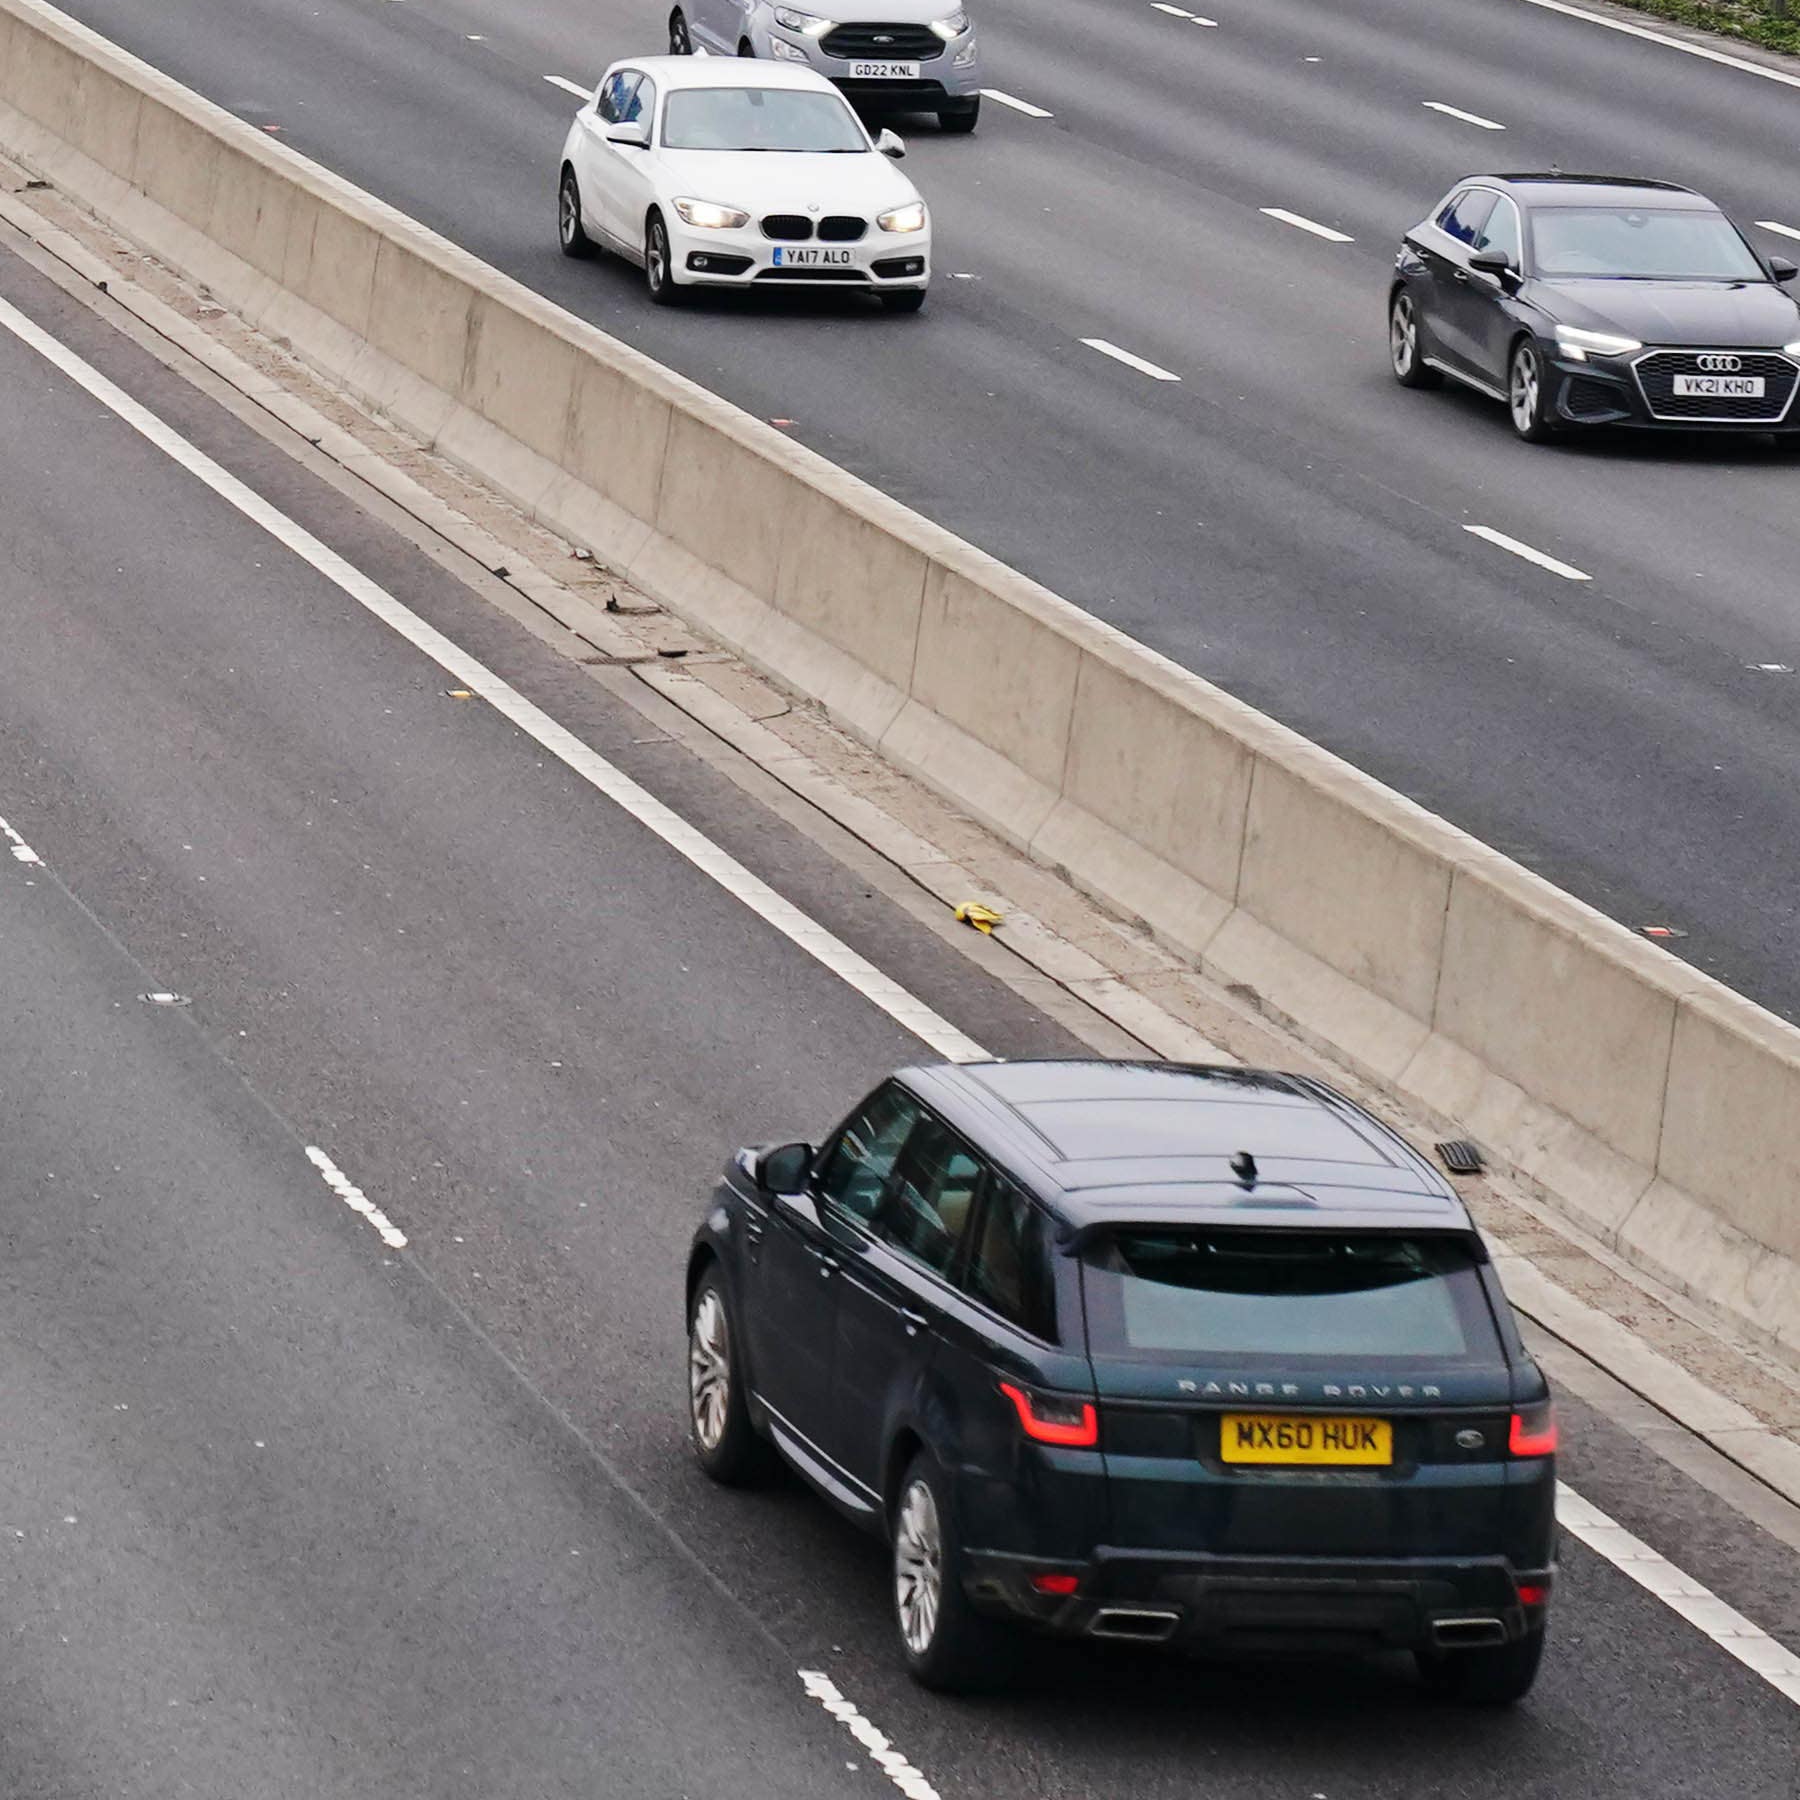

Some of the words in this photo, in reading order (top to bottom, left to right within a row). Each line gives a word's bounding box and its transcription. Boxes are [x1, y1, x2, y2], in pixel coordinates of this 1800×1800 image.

[855, 64, 887, 76] GD22
[890, 65, 914, 76] KNL
[787, 250, 818, 263] YA17
[1684, 378, 1719, 393] VK21
[1177, 1379, 1299, 1395] RANGE
[1322, 1383, 1441, 1398] ROVER
[1237, 1421, 1313, 1450] MX60
[1322, 1423, 1377, 1451] HUK
